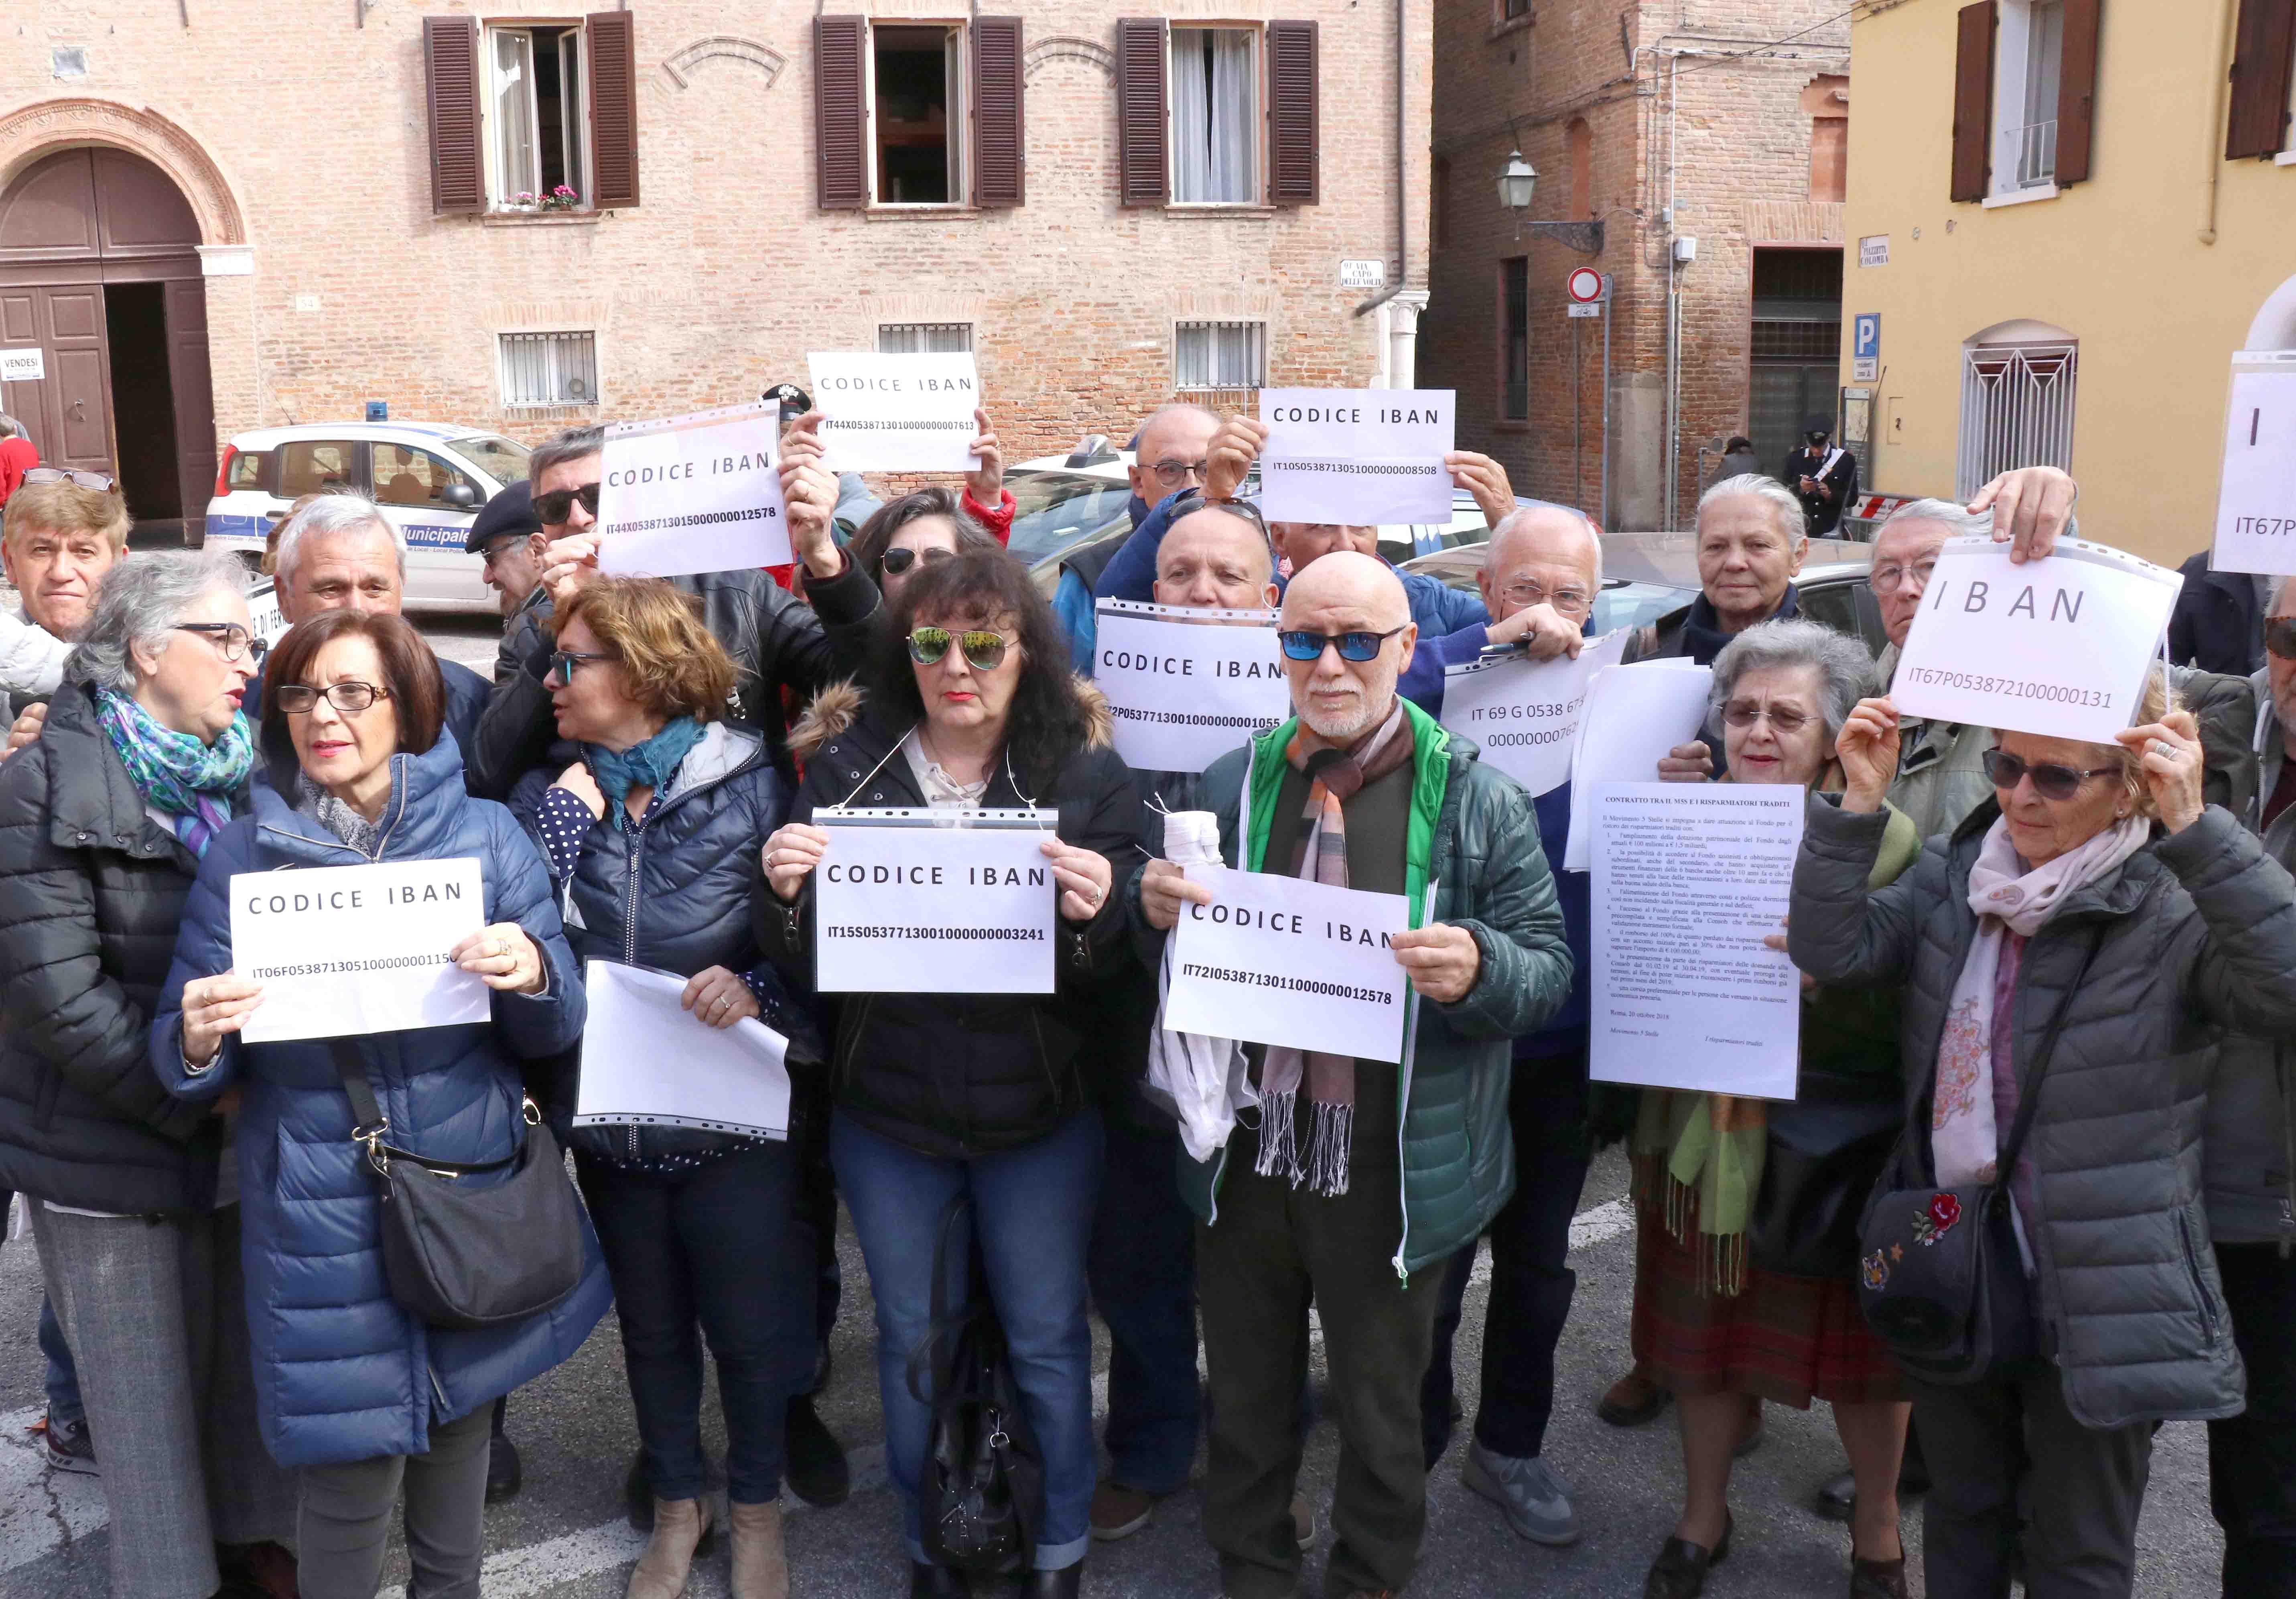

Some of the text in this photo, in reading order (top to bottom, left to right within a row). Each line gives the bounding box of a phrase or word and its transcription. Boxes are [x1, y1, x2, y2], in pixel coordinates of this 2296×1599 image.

[1861, 255, 1888, 264] COLOMBA
[1864, 245, 1886, 256] PIAZZETTA
[1859, 319, 1875, 354] P
[4, 358, 37, 367] VENDESI
[821, 378, 970, 391] CODICE IBAN
[826, 421, 973, 429] IT44X0538713010000000007613
[1274, 408, 1437, 423] CODICE IBAN
[609, 452, 768, 487] CODICE IBAN
[1274, 463, 1436, 474] IT10S0538713051000000008508
[607, 507, 776, 534] IT44X0538713015000000012578
[1934, 581, 2083, 623] IBAN
[1104, 651, 1282, 678] CODICE IBAN
[1910, 668, 2111, 708] IT67P053872100000131
[1472, 691, 1588, 721] IT 69 G 0538 673
[828, 865, 1043, 886] CODICE IBAN
[250, 883, 460, 914] CODICE IBAN
[829, 927, 1044, 940] IT15S0537713001000000003241
[1191, 904, 1396, 948] CODICE IBAN
[1184, 964, 1391, 1004] IT72I0538713011000000012578
